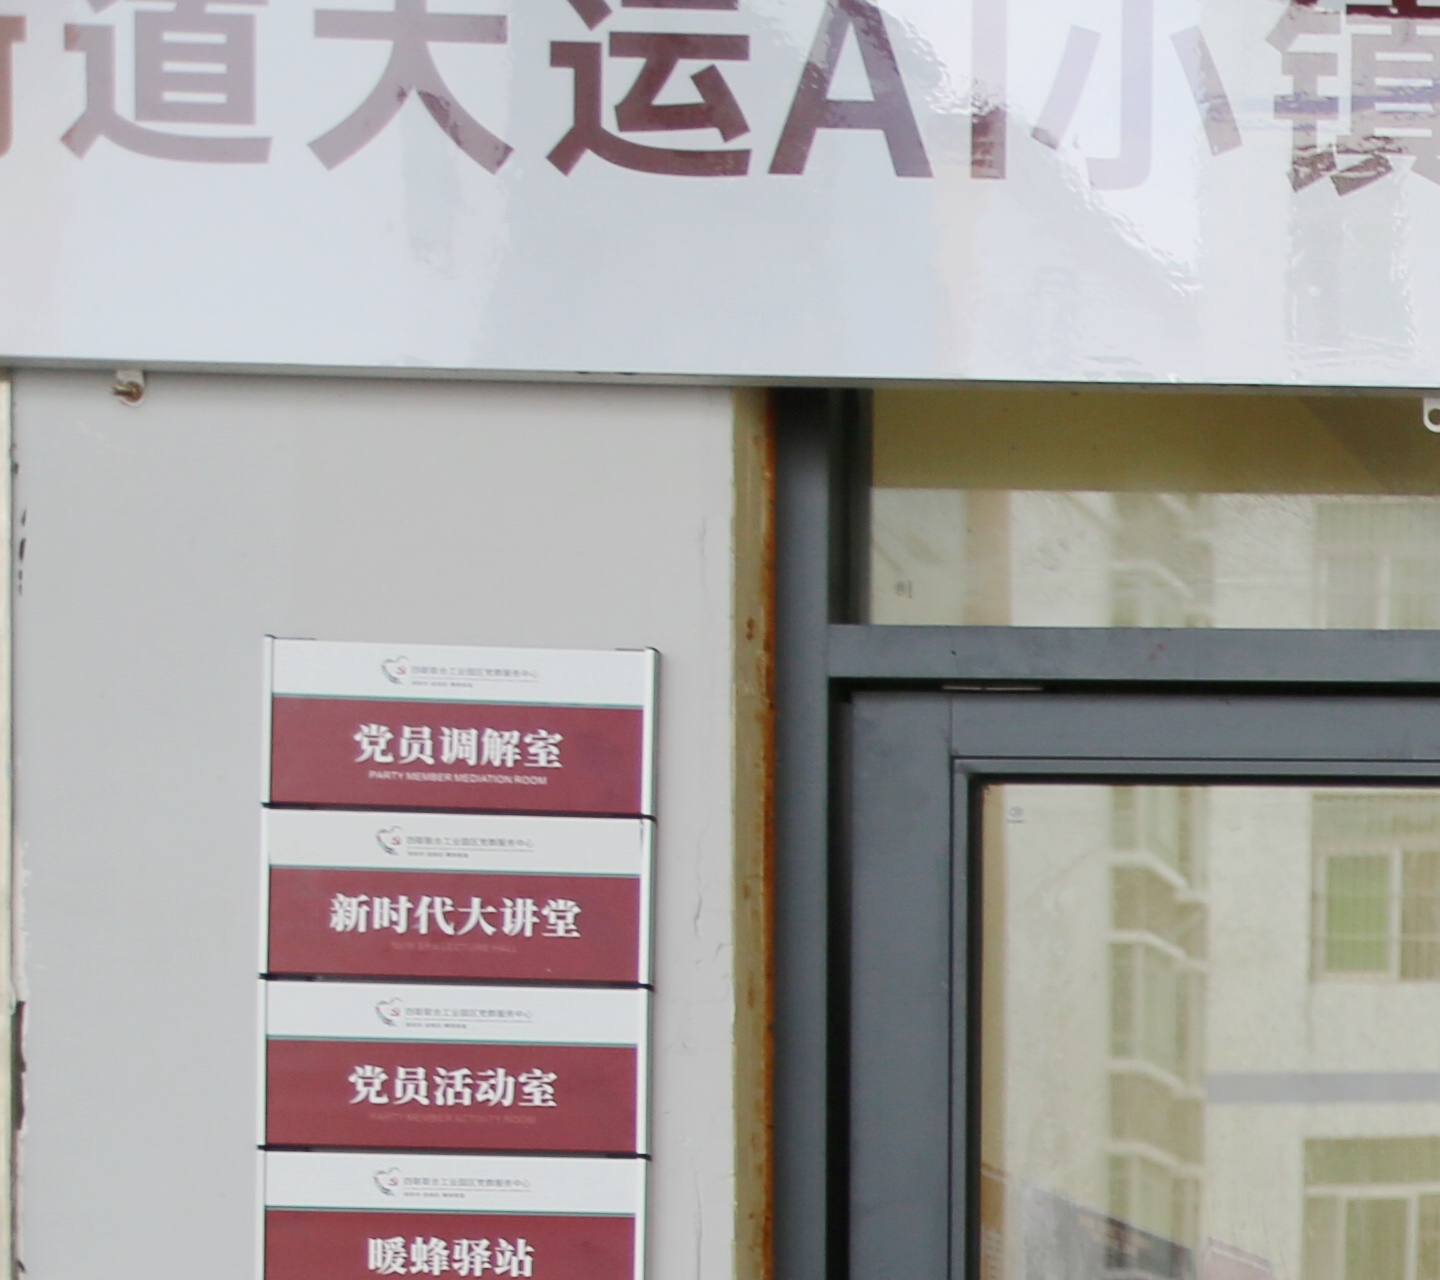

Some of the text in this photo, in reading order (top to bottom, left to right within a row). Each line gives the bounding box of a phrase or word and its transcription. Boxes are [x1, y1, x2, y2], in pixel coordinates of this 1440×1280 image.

[354, 723, 564, 770] 党员调解室
[368, 770, 547, 786] PARTY MEMBER MEDIATION ROOM
[329, 893, 582, 939] 新时代大讲堂
[348, 1065, 558, 1108] 党员活动室
[367, 1236, 535, 1278] 暖蜂驿站
